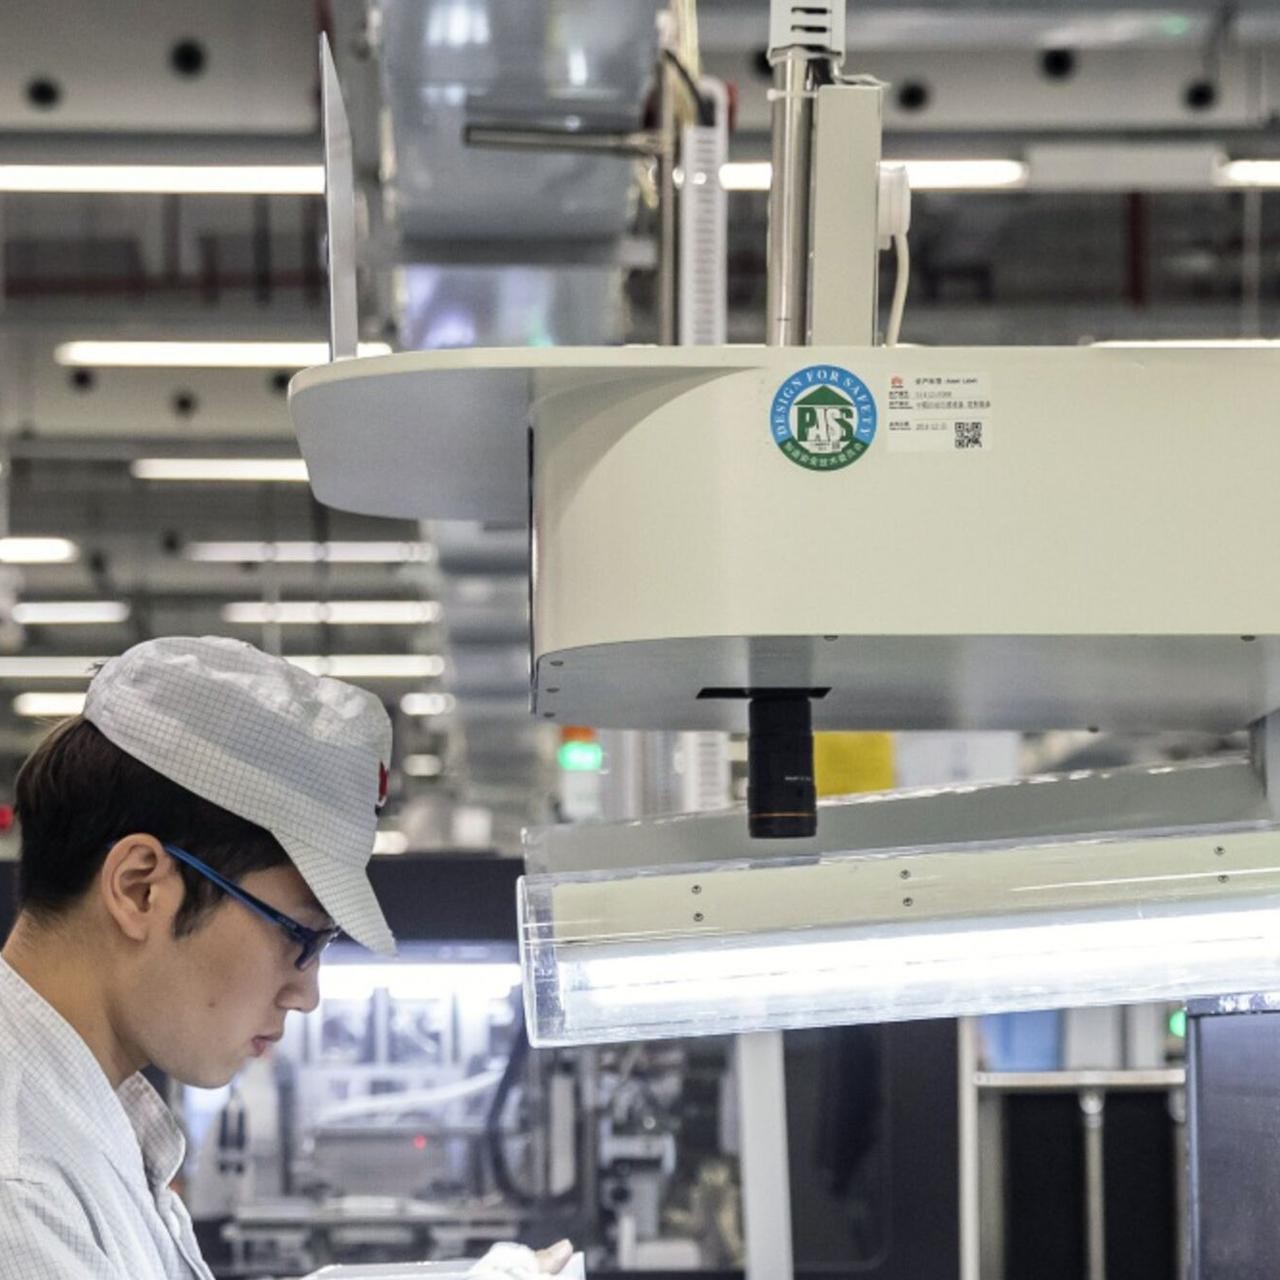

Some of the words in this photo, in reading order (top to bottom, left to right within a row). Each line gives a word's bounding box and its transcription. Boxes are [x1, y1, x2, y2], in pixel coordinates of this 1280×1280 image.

[776, 379, 803, 435] DESIGN
[806, 370, 839, 382] FOR
[843, 377, 871, 434] SAFETY
